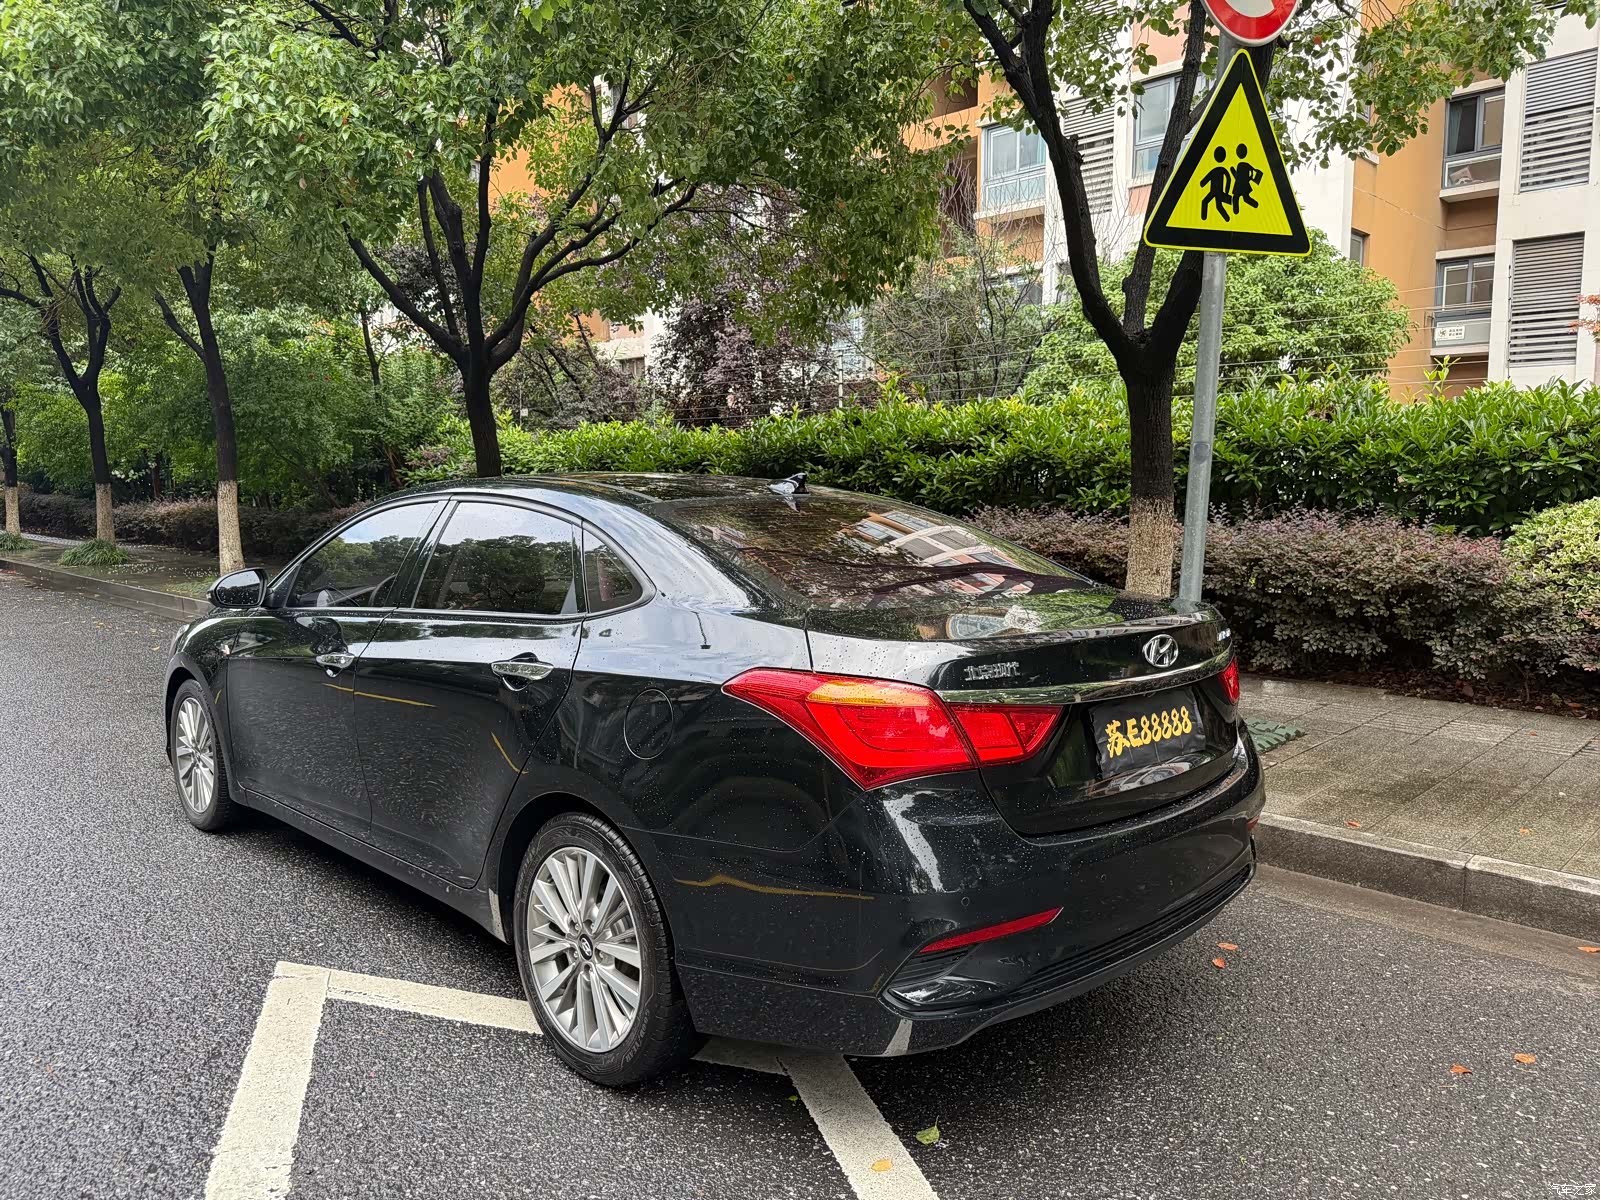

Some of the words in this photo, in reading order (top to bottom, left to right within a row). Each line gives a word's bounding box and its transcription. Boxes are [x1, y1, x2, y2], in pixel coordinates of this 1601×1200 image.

[964, 661, 1020, 681] 北京现代
[1105, 706, 1192, 758] 苏E88888
